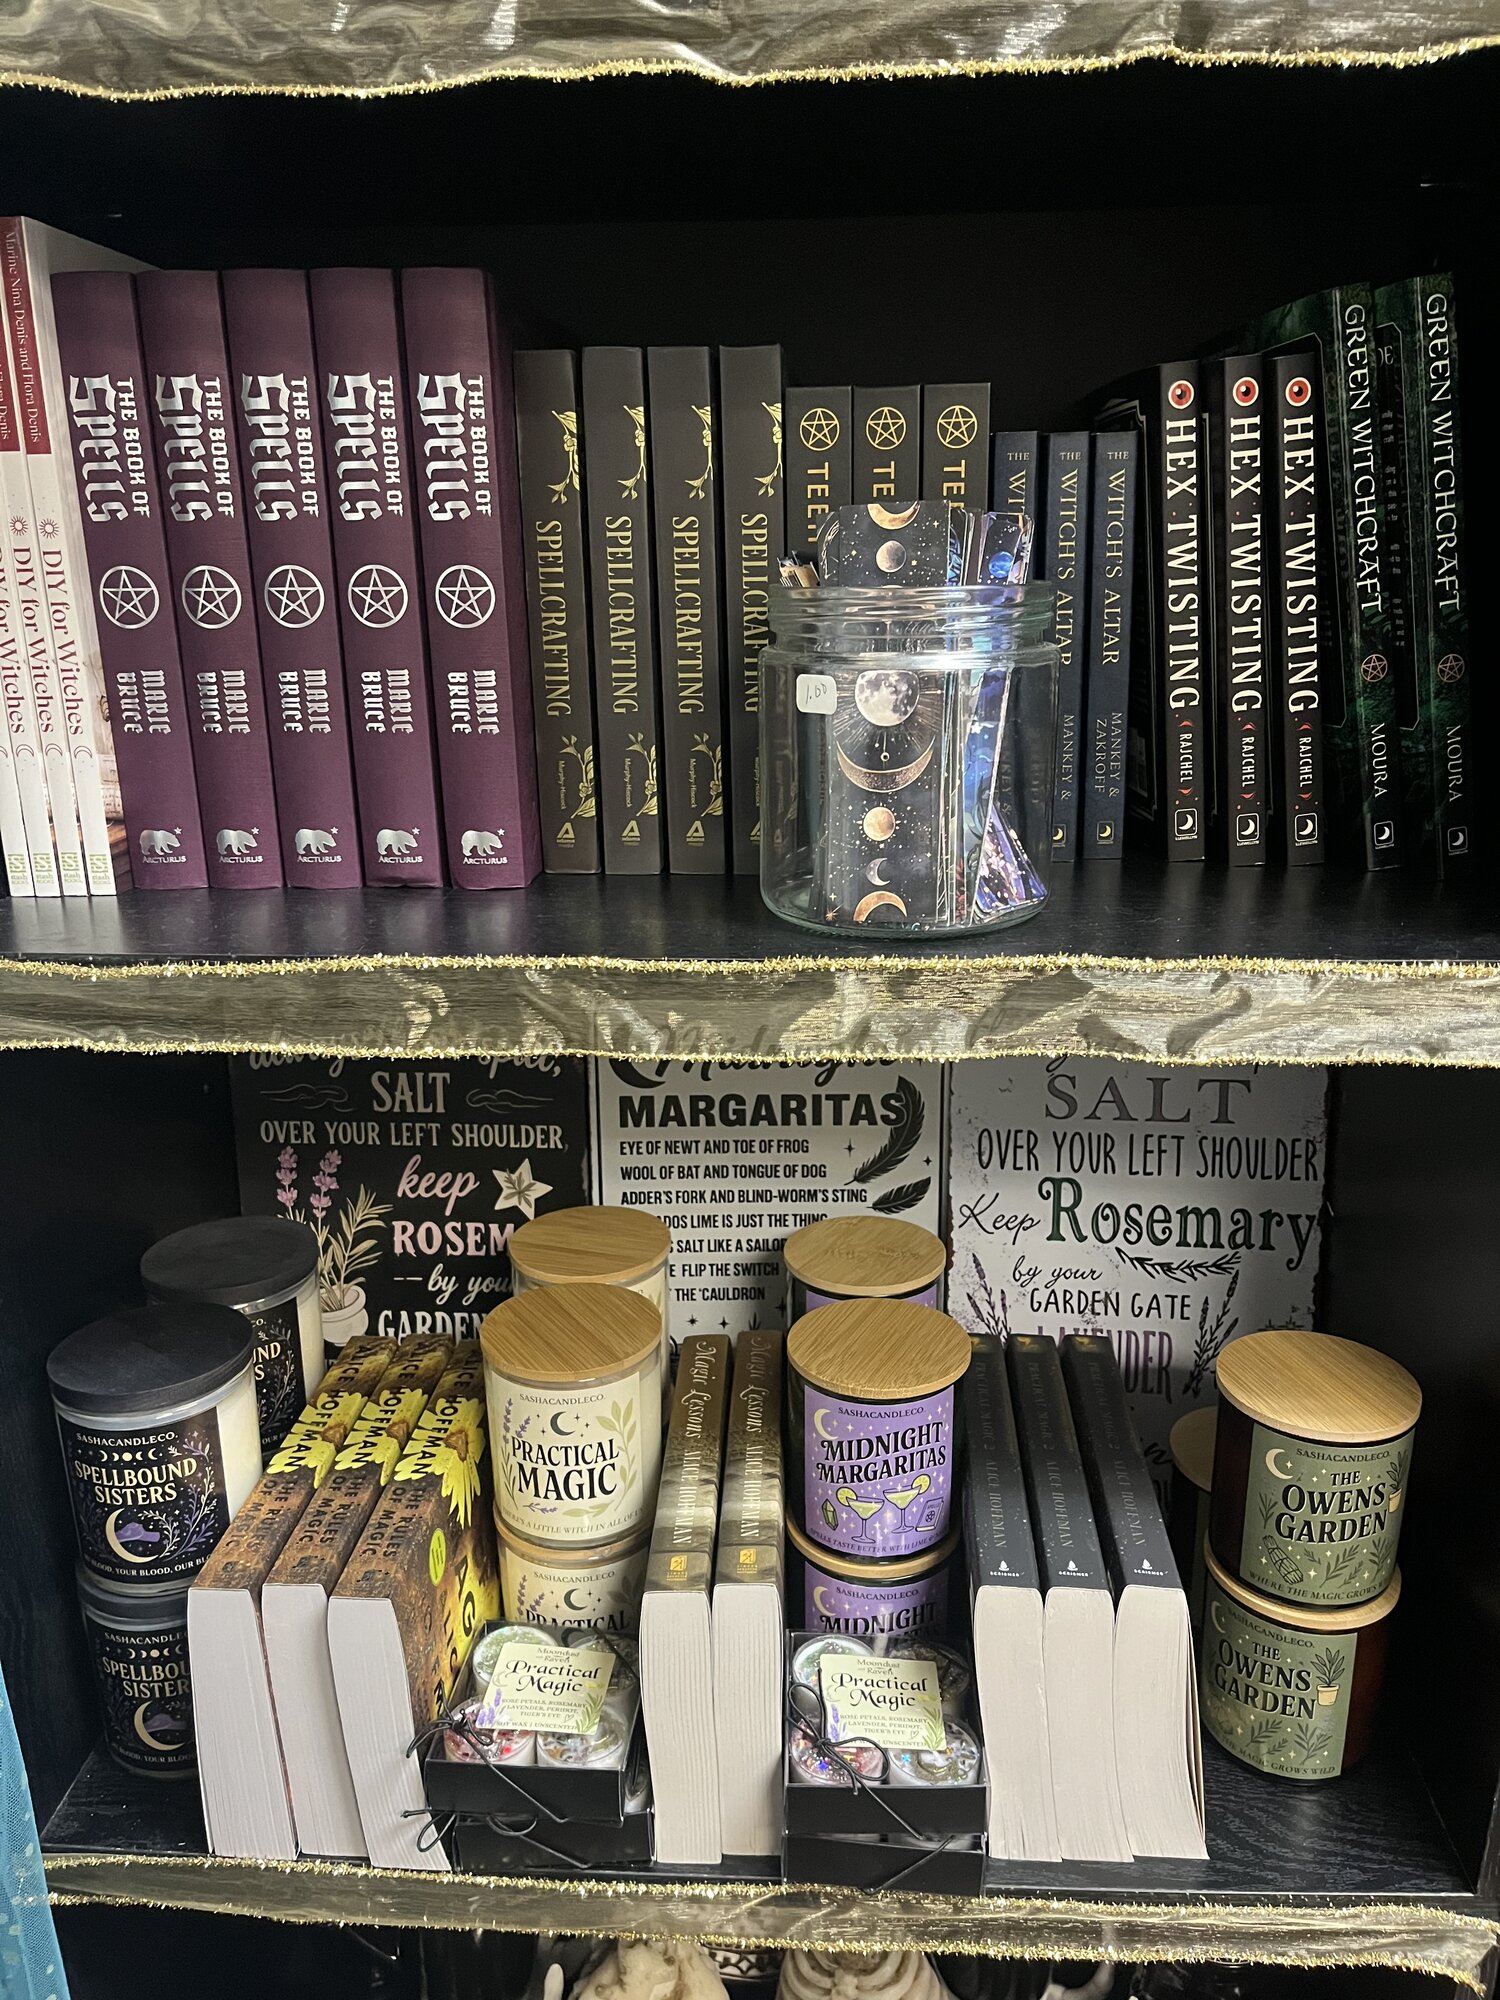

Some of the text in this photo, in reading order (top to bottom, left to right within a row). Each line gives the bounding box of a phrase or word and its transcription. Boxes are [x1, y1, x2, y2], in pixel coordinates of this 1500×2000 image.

[10, 280, 42, 443] Nina Denis and Flora Denis
[117, 376, 149, 518] THE BOOK OF
[203, 376, 234, 518] THE BOOK OF
[289, 375, 319, 517] THE BOOK OF
[1007, 452, 1030, 462] THE
[1059, 452, 1082, 462] THE
[1107, 451, 1130, 461] THE
[1344, 304, 1382, 613] GREEN WITCHCRAFT
[1426, 293, 1460, 611] GREEN WITCHCRAFT
[1054, 467, 1078, 665] WITCH'S ALTAR
[1102, 467, 1126, 665] WITCH'S ALTAR
[1165, 418, 1200, 710] HEX TWISTING
[1230, 415, 1262, 713] HEX TWISTING
[1283, 415, 1319, 713] HEX TWISTING
[13, 548, 54, 734] DIY for Witches
[535, 520, 572, 718] SPELLCRAFTING
[605, 515, 637, 716] SPELLCRAFTING
[672, 515, 705, 716] SPELLCRAFTING
[42, 549, 84, 737] DIY for Witches
[117, 672, 143, 733] BRUCE
[140, 670, 171, 734] MARIE
[197, 672, 223, 733] BRUCE
[221, 670, 250, 734] MARIE
[278, 671, 303, 733] BRUCE
[303, 669, 331, 734] MARIE
[1061, 714, 1075, 800] MANKEY &
[1094, 719, 1107, 793] ZAKROFF
[1109, 713, 1122, 798] MANKEY &
[1179, 732, 1193, 783] RAJCHEL
[1241, 736, 1255, 788] RAJCHEL
[1299, 736, 1312, 788] RAJCHEL
[1370, 722, 1388, 798] MOURA
[1446, 725, 1463, 802] MOURA
[218, 855, 263, 865] ARCTURUS
[370, 1071, 450, 1114] SALT
[618, 1093, 906, 1128] MARGARITAS
[1044, 1073, 1252, 1124] SALT
[259, 1120, 440, 1147] OVER YOUR LEFT
[620, 1139, 810, 1156] EYE OF NEWT AND TOE OF FROG
[978, 1128, 1319, 1182] OVER YOUR LEFT SHOULDER
[397, 1154, 480, 1217] keep
[620, 1164, 827, 1180] WOOL OF BAT AND TONGUE OF DOG
[621, 1188, 868, 1205] ADDER'S FORK AND BLIND-WORM'S STING
[677, 1239, 744, 1253] SALT LIKE A
[691, 1214, 719, 1229] LIME
[722, 1214, 733, 1229] IS
[736, 1214, 765, 1229] JUST
[767, 1213, 790, 1228] THE
[958, 1176, 1318, 1272] Keep Rosemary
[428, 1263, 459, 1305] by
[675, 1288, 697, 1301] THE
[682, 1262, 780, 1277] FLIP THE SWITCH
[1012, 1255, 1104, 1288] by your
[1030, 1288, 1191, 1321] GARDEN GATE
[681, 1340, 717, 1439] Magic Lessons
[739, 1384, 770, 1434] Lessons
[283, 1390, 344, 1468] HOFFMAN
[349, 1384, 406, 1465] HOFFMAN
[410, 1395, 462, 1476] HOFFMAN
[820, 1422, 943, 1462] MIDNIGHT
[74, 1457, 198, 1488] SPELLBOUND
[511, 1435, 620, 1466] PRACTICAL
[816, 1445, 946, 1484] MARGARITAS
[95, 1482, 177, 1506] SISTERS
[517, 1461, 617, 1501] MAGIC
[1281, 1482, 1388, 1516] OWENS
[1330, 1471, 1362, 1487] THE
[533, 1523, 594, 1534] LITTLE WITCH
[1275, 1509, 1389, 1544] GARDEN
[174, 1561, 194, 1572] OUR
[1249, 1571, 1380, 1600] WHERE THE MAGIC GROWS
[819, 1602, 937, 1635] MIDNIGHT
[504, 1659, 603, 1681] Practical
[537, 1648, 581, 1659] Moondust
[1218, 1639, 1312, 1692] OWENS
[1252, 1641, 1281, 1661] THE
[515, 1674, 583, 1697] Magic
[830, 1672, 928, 1693] Practical
[849, 1688, 916, 1712] Magic
[1214, 1664, 1317, 1720] GARDEN
[1271, 1763, 1336, 1775] GROWS WILD
